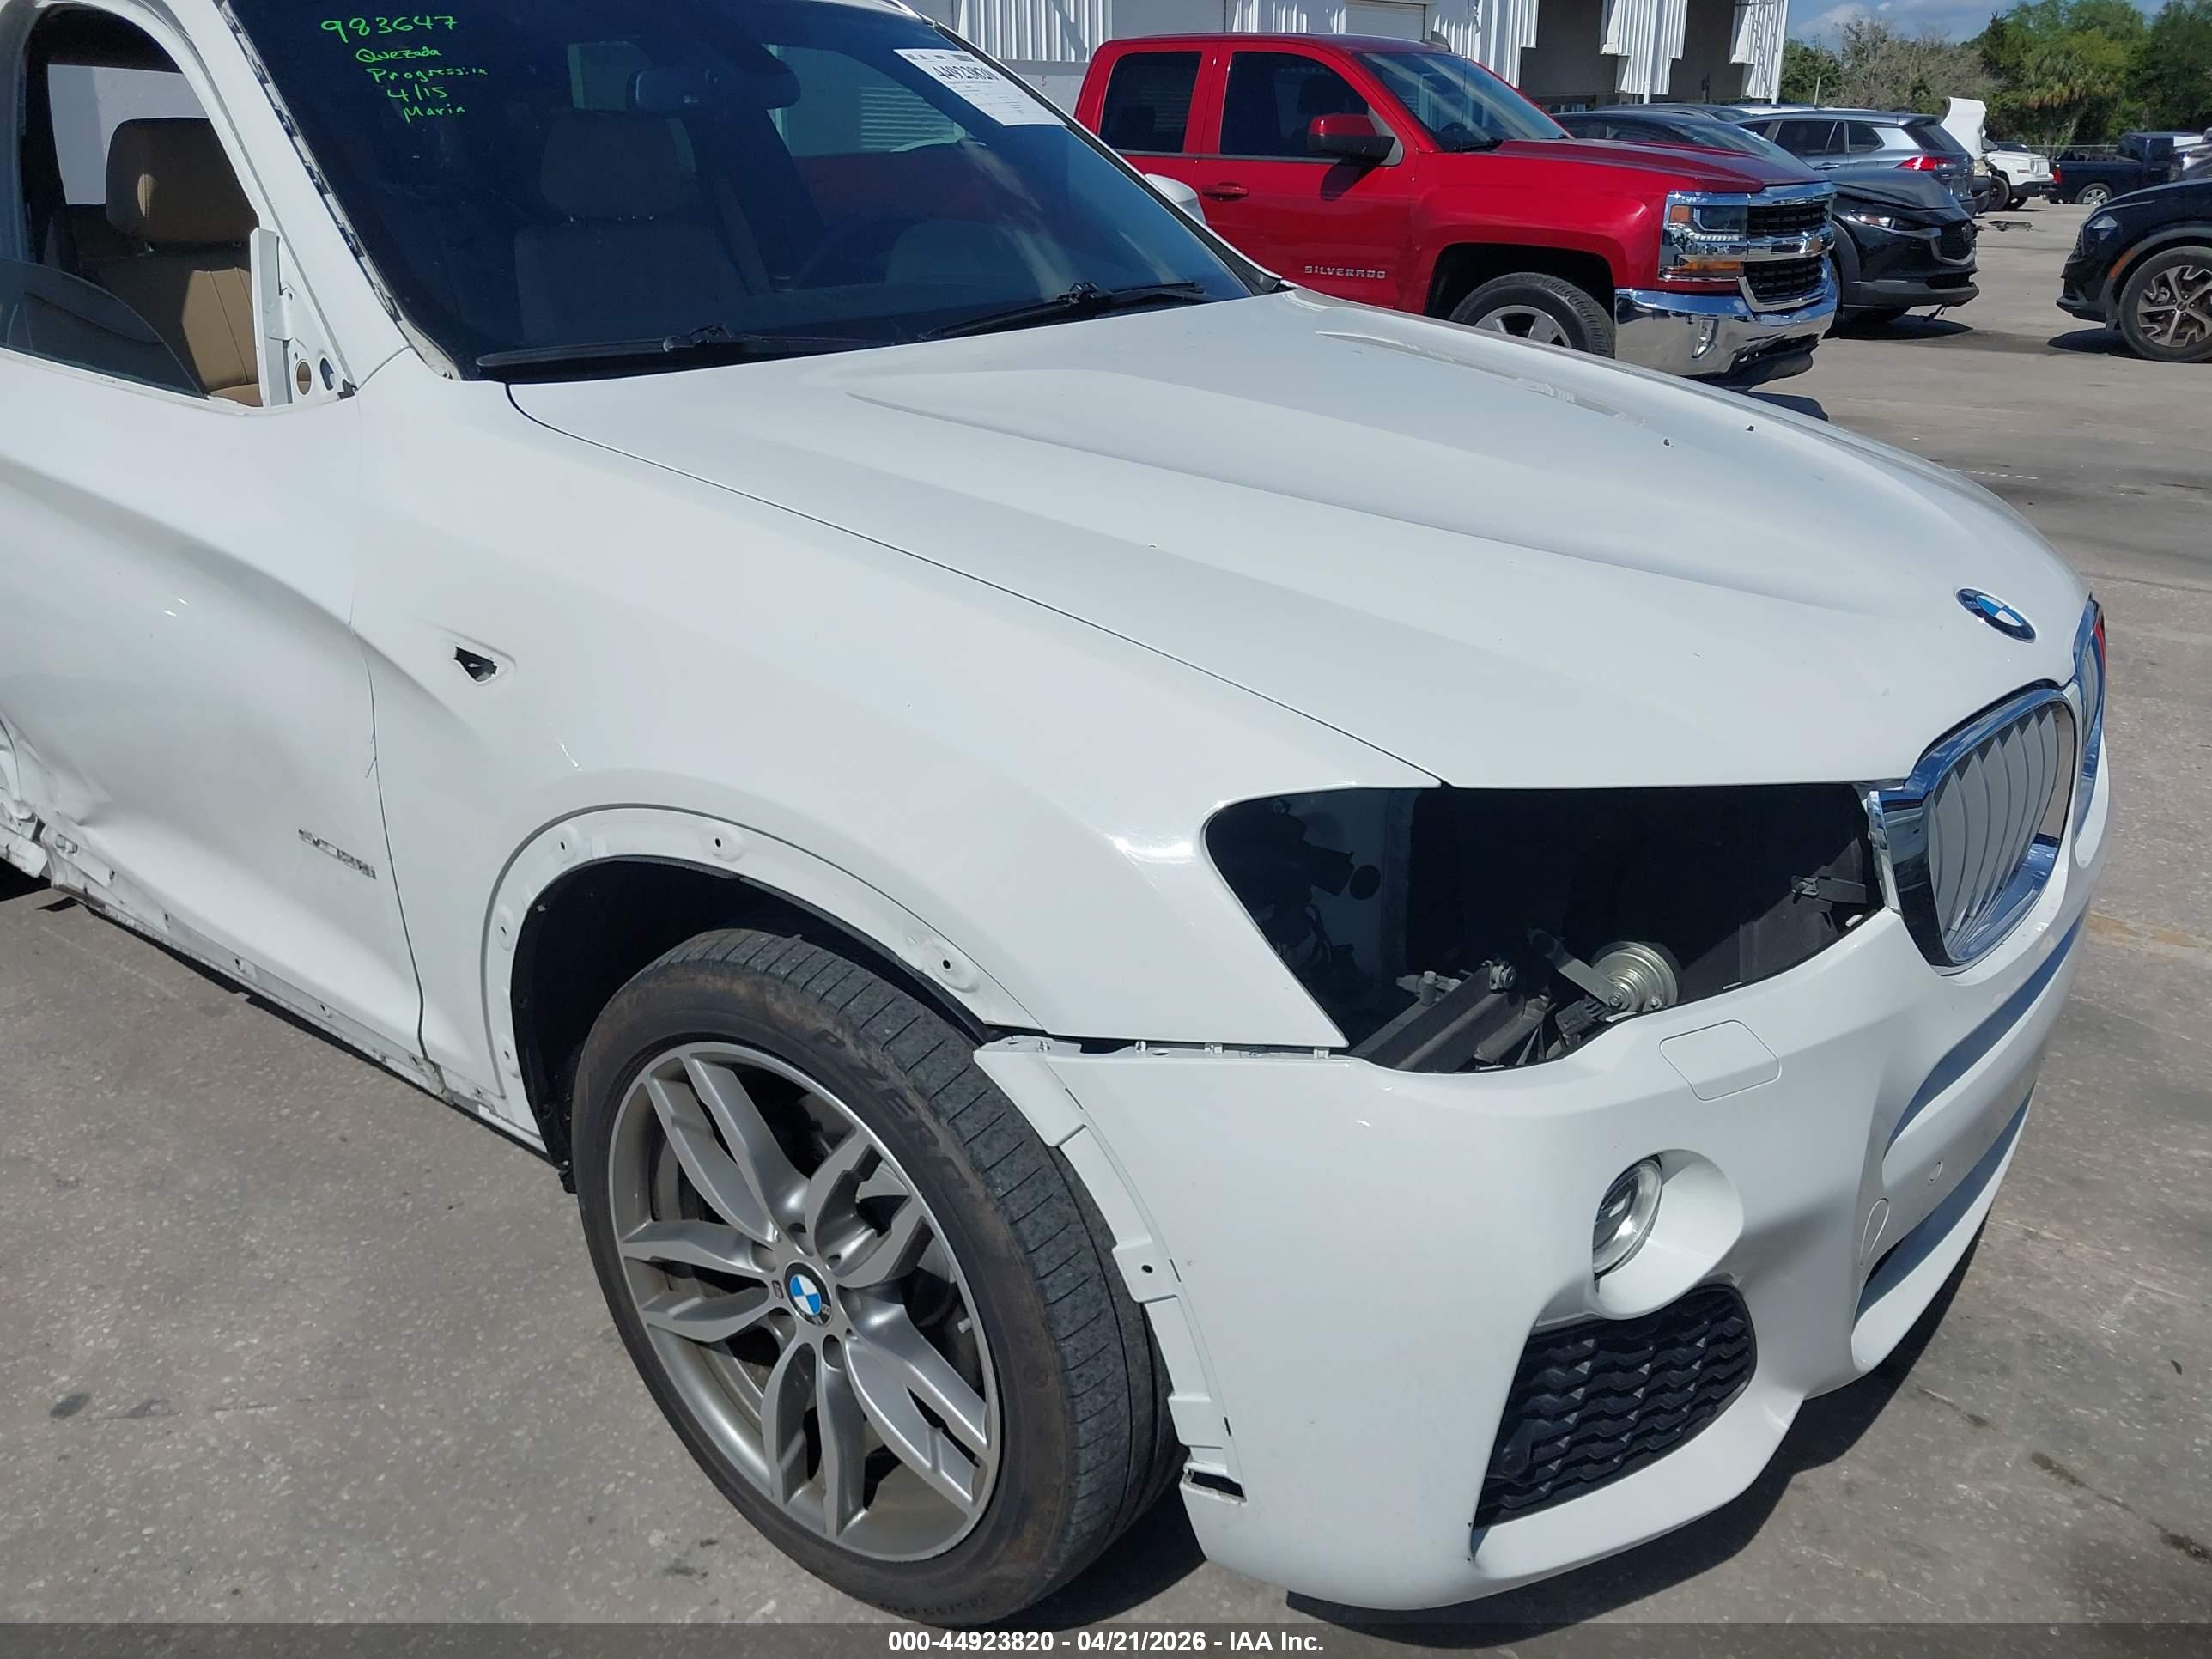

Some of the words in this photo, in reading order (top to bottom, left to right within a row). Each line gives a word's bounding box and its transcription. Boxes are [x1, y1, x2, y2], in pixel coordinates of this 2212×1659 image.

[321, 15, 458, 43] 983647
[356, 46, 442, 63] Quezada
[387, 84, 448, 102] 4/15
[403, 103, 466, 123] Maria
[1304, 265, 1387, 280] SILVERADO
